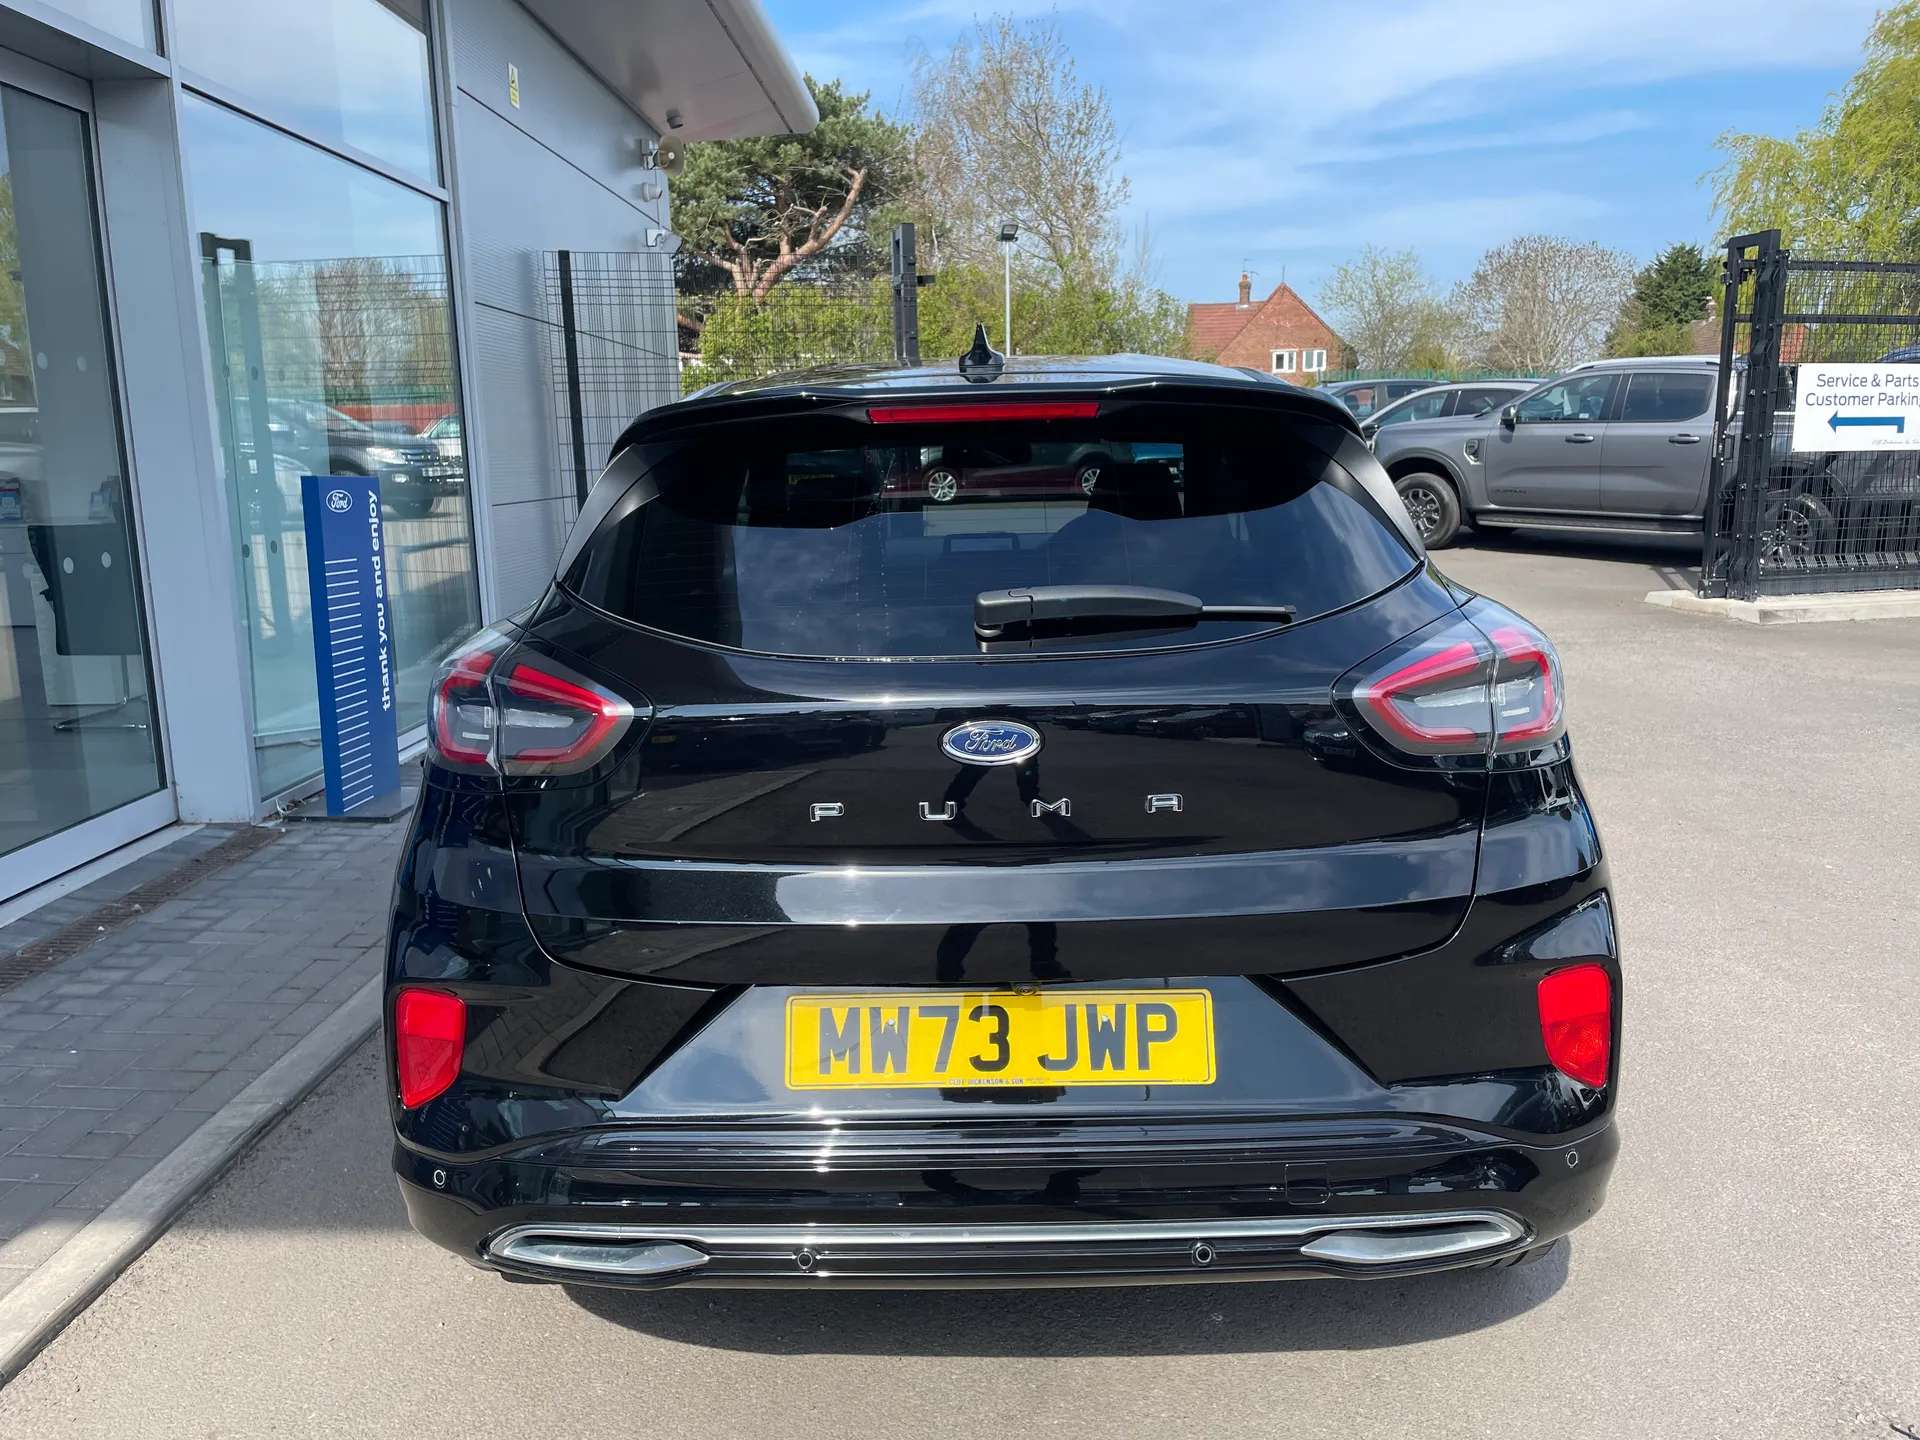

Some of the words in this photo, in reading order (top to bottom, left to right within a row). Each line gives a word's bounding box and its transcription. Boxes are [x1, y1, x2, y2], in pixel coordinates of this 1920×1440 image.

[1816, 373, 1868, 387] Service
[1871, 373, 1881, 387] &
[1885, 373, 1919, 387] Parts
[1805, 392, 1875, 406] Customer
[1878, 392, 1920, 408] Parkin
[331, 492, 349, 509] Ford
[368, 489, 380, 552] enjoy
[371, 555, 384, 599] and
[377, 603, 388, 644] you
[379, 646, 391, 712] thank
[964, 728, 1018, 753] Ford
[810, 793, 1184, 823] PUMA
[818, 1004, 1011, 1076] MW73
[1036, 1002, 1179, 1072] JWP
